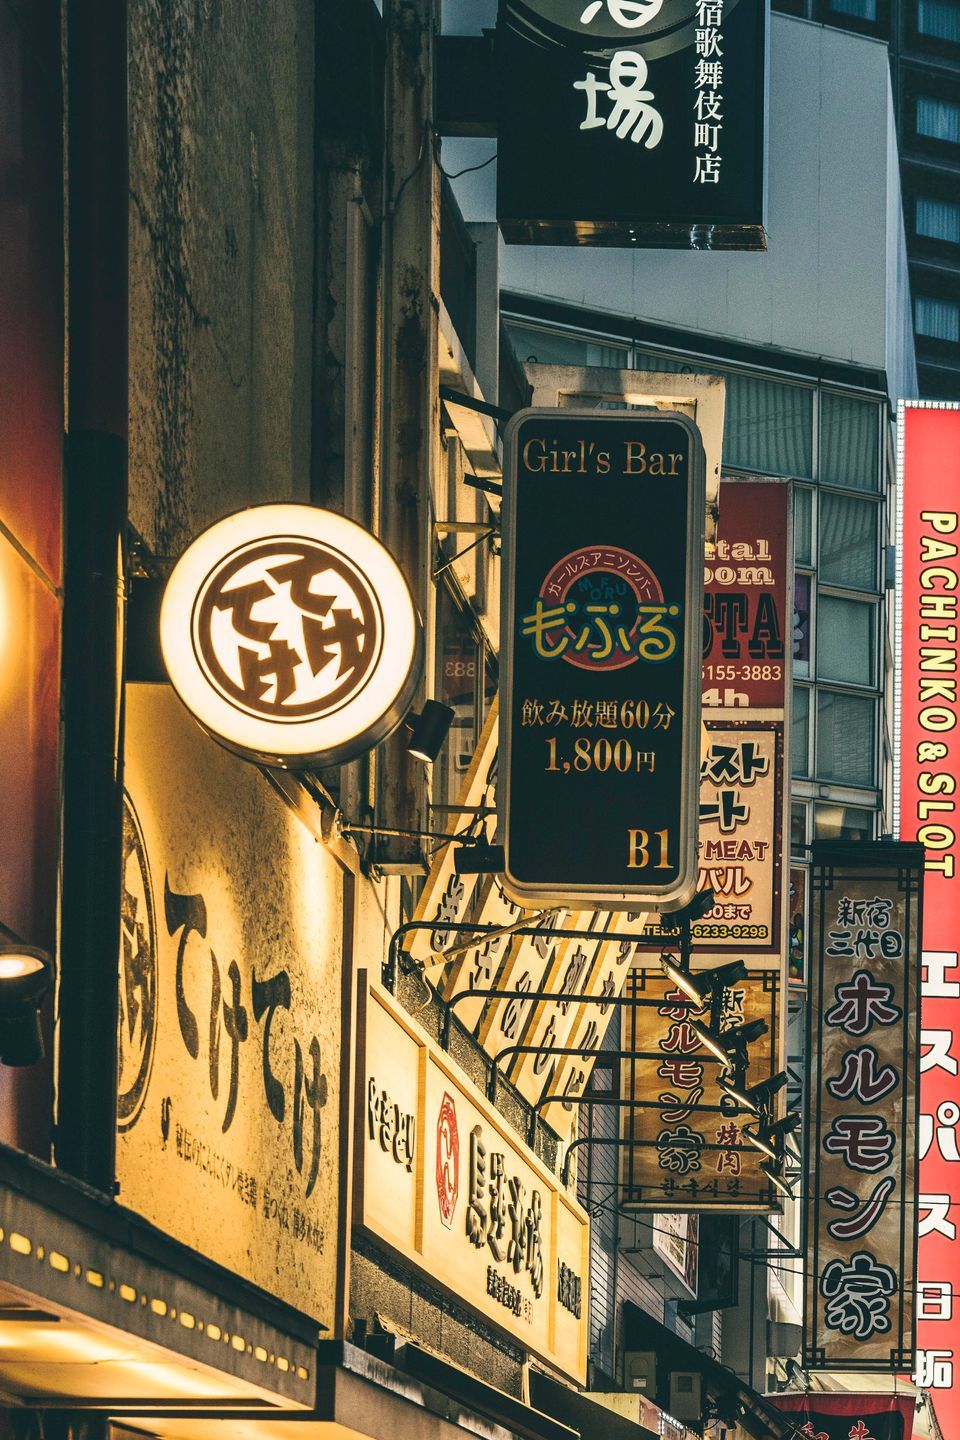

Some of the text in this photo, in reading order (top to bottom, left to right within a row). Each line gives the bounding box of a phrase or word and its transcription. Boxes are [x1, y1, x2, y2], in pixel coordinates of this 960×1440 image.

[692, 0, 724, 184] 宿歌舞伎町店
[522, 438, 684, 476] Girl's Bar
[917, 510, 960, 733] PACHINKO
[521, 699, 677, 731] 飲み放題60分
[544, 736, 657, 775] 1,800円
[626, 828, 675, 869] B1
[917, 772, 957, 879] SLOT
[825, 929, 904, 961] 三代目
[837, 897, 893, 931] 新宿
[163, 870, 329, 1199] てけてけ
[659, 984, 705, 1175] ホルモン家
[819, 971, 902, 1342] ホルモン家
